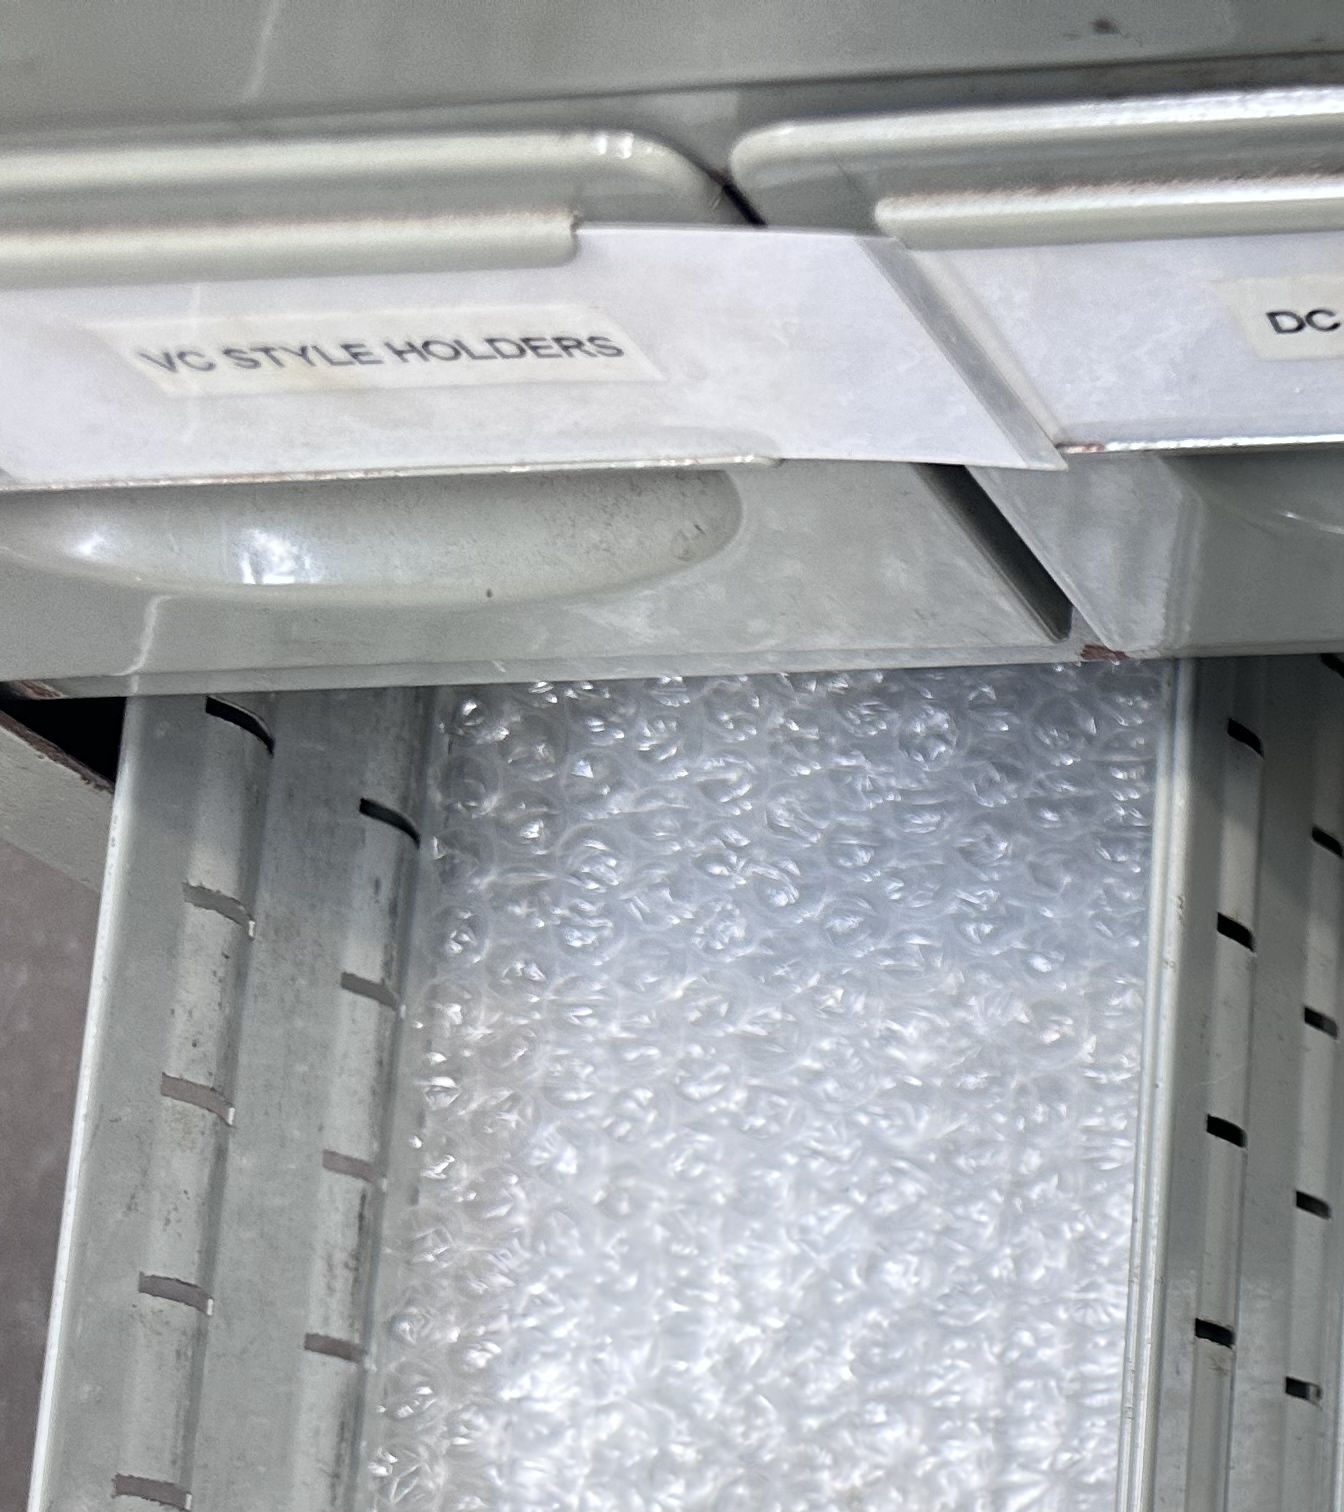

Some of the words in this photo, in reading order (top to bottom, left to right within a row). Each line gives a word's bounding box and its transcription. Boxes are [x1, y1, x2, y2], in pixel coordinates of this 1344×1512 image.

[1266, 307, 1342, 336] DC
[137, 347, 217, 375] VC
[223, 341, 376, 372] STYLE
[384, 334, 626, 364] HOLDERS
